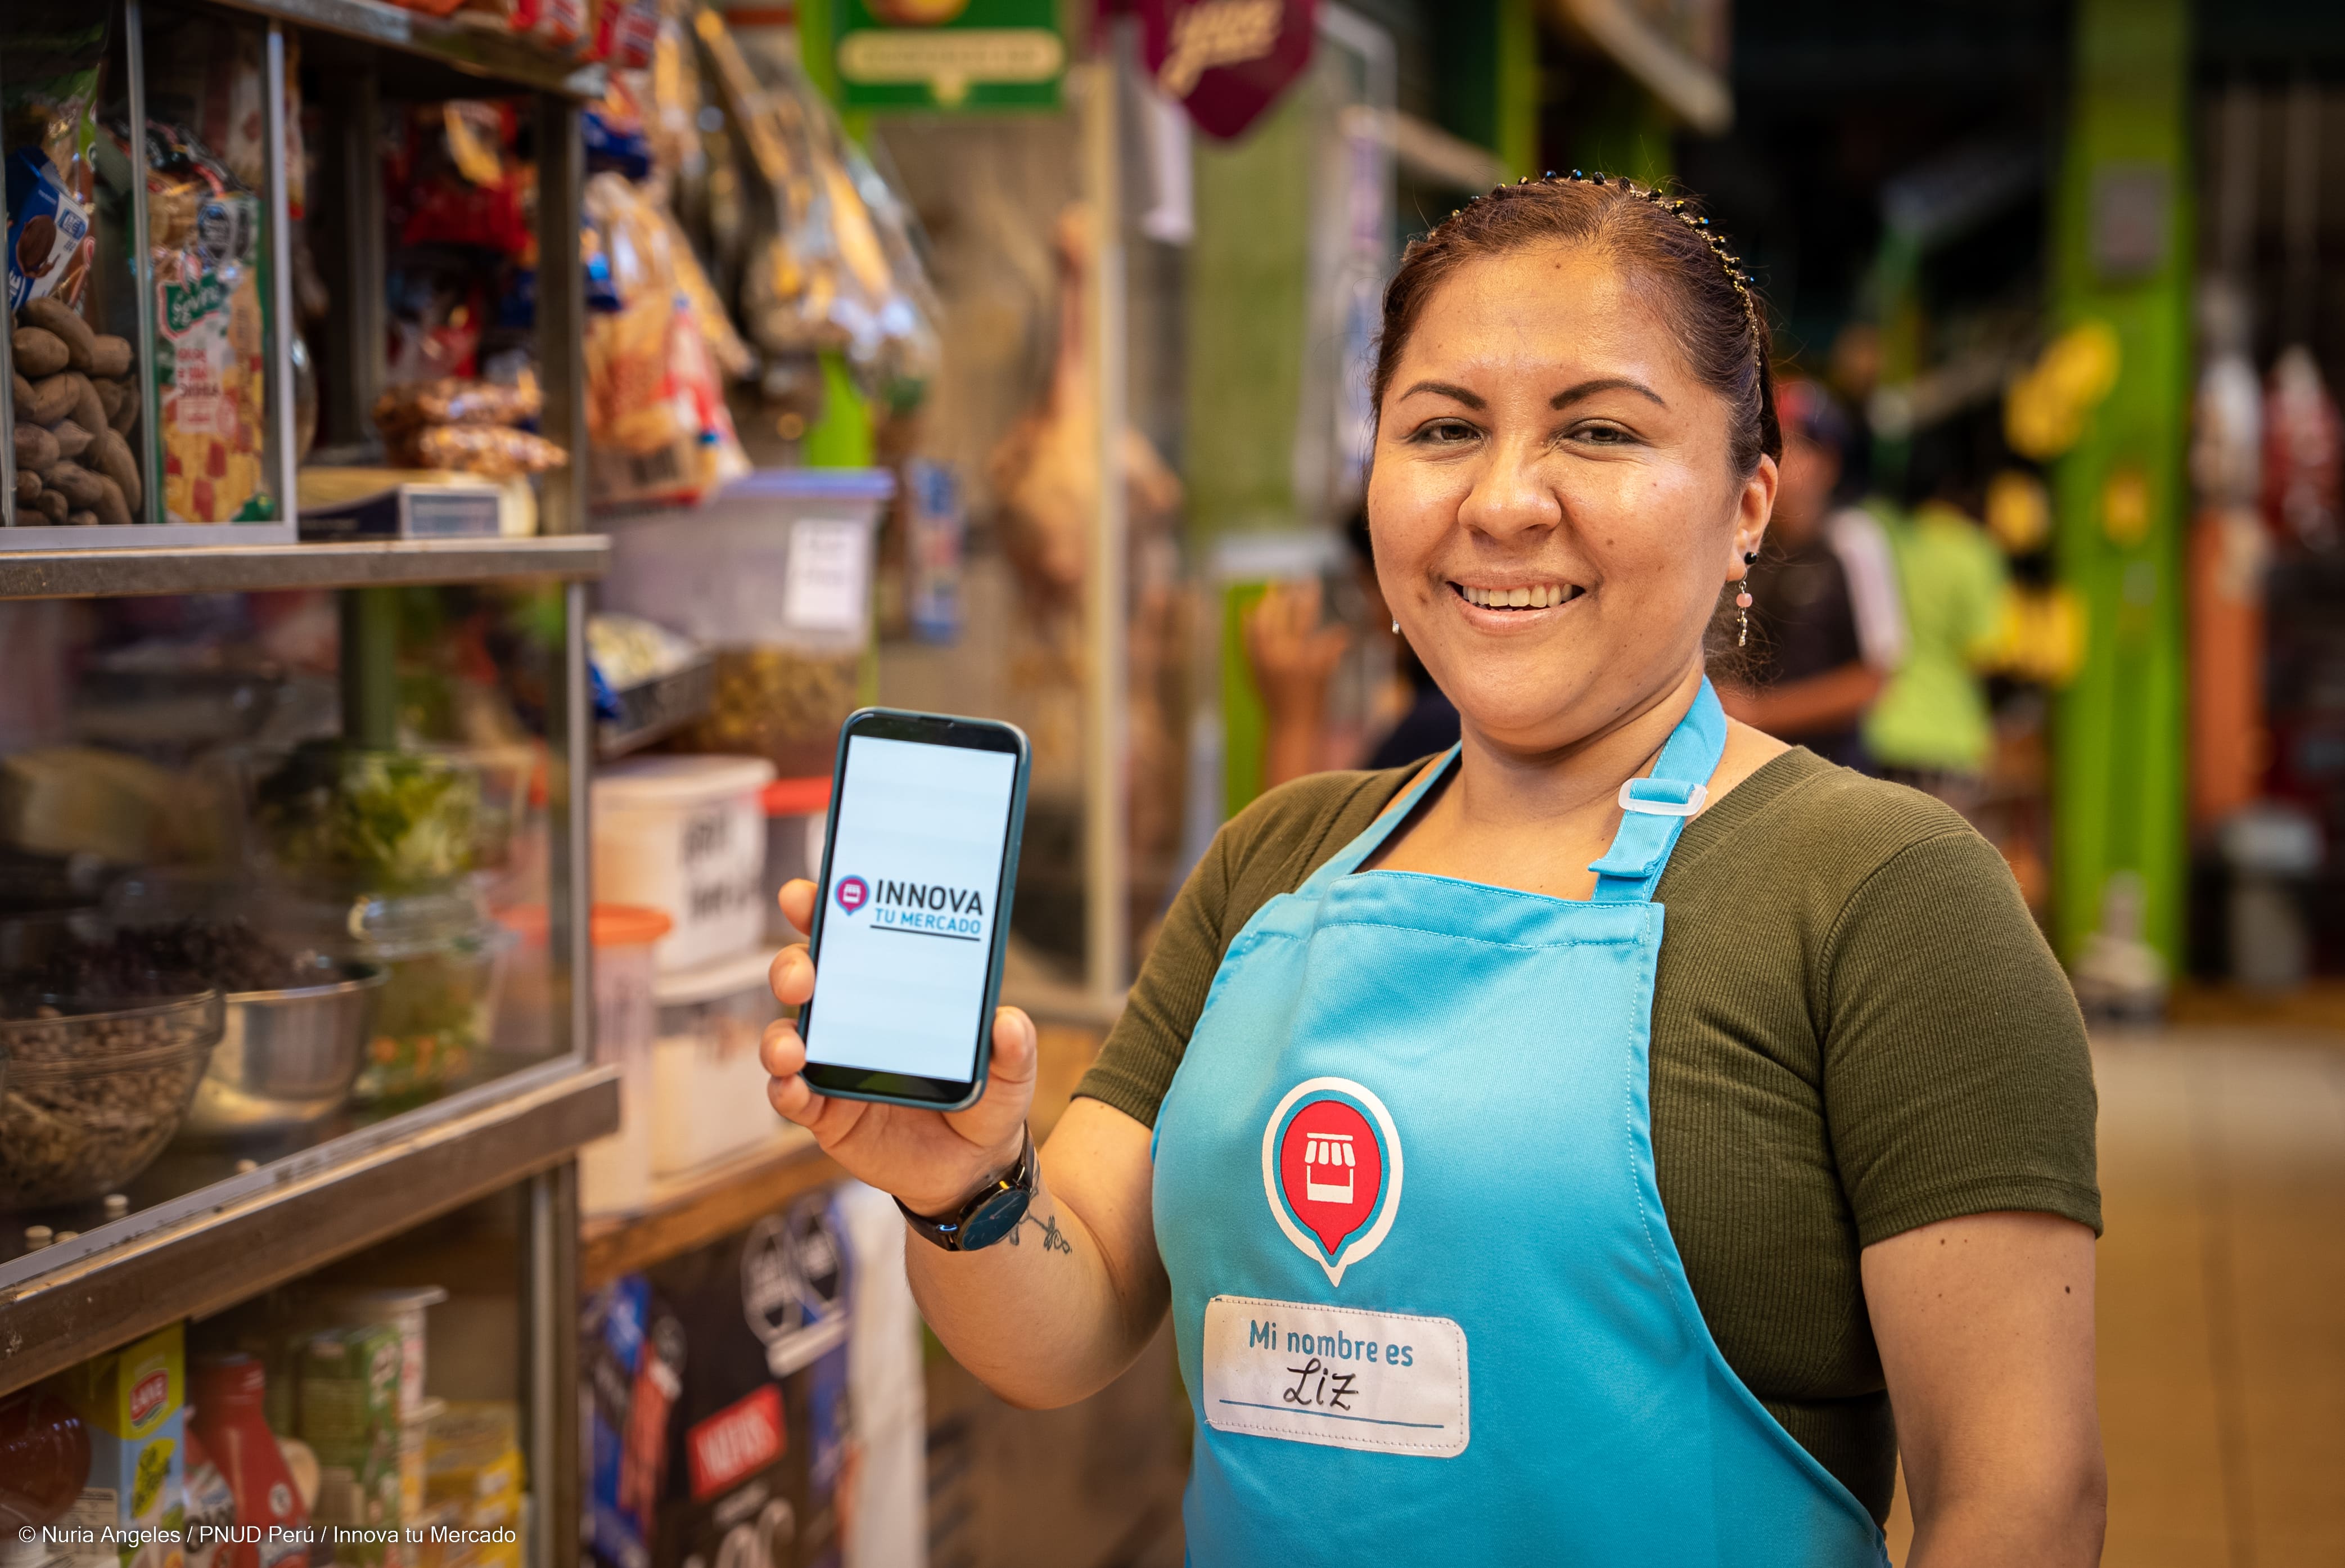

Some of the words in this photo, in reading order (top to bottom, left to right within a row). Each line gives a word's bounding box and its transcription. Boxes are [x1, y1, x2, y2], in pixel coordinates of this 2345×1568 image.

[875, 879, 983, 916] INNOVA
[875, 907, 896, 924] TU
[900, 911, 981, 935] MERCADO
[1250, 1319, 1277, 1351] Mi
[1287, 1330, 1378, 1363] nombre
[1385, 1344, 1414, 1367] es
